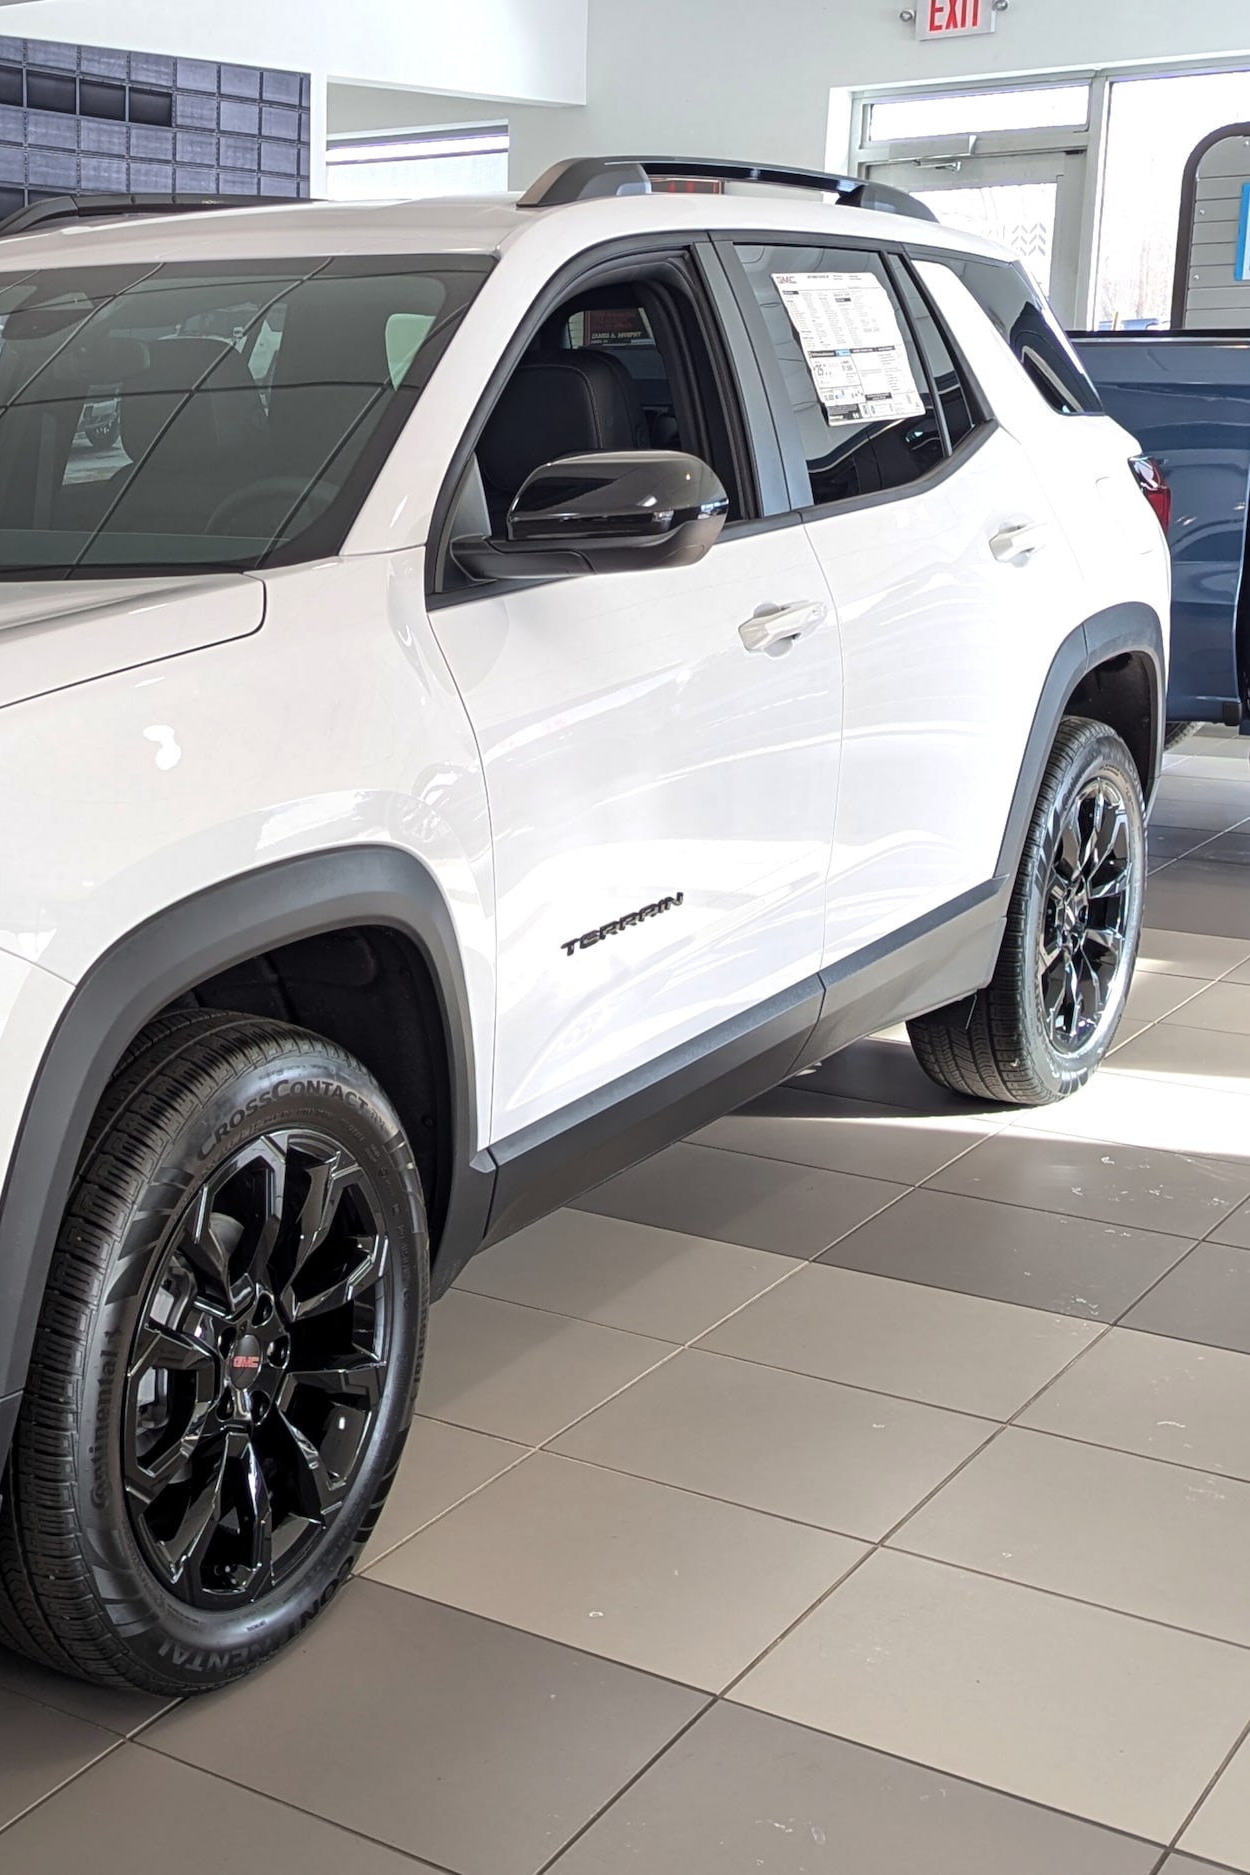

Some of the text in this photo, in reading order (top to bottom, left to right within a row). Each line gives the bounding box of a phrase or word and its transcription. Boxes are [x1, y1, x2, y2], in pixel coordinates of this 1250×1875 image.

[560, 891, 684, 957] TERRAIN
[233, 1356, 259, 1368] GMC
[90, 1350, 118, 1510] Continental
